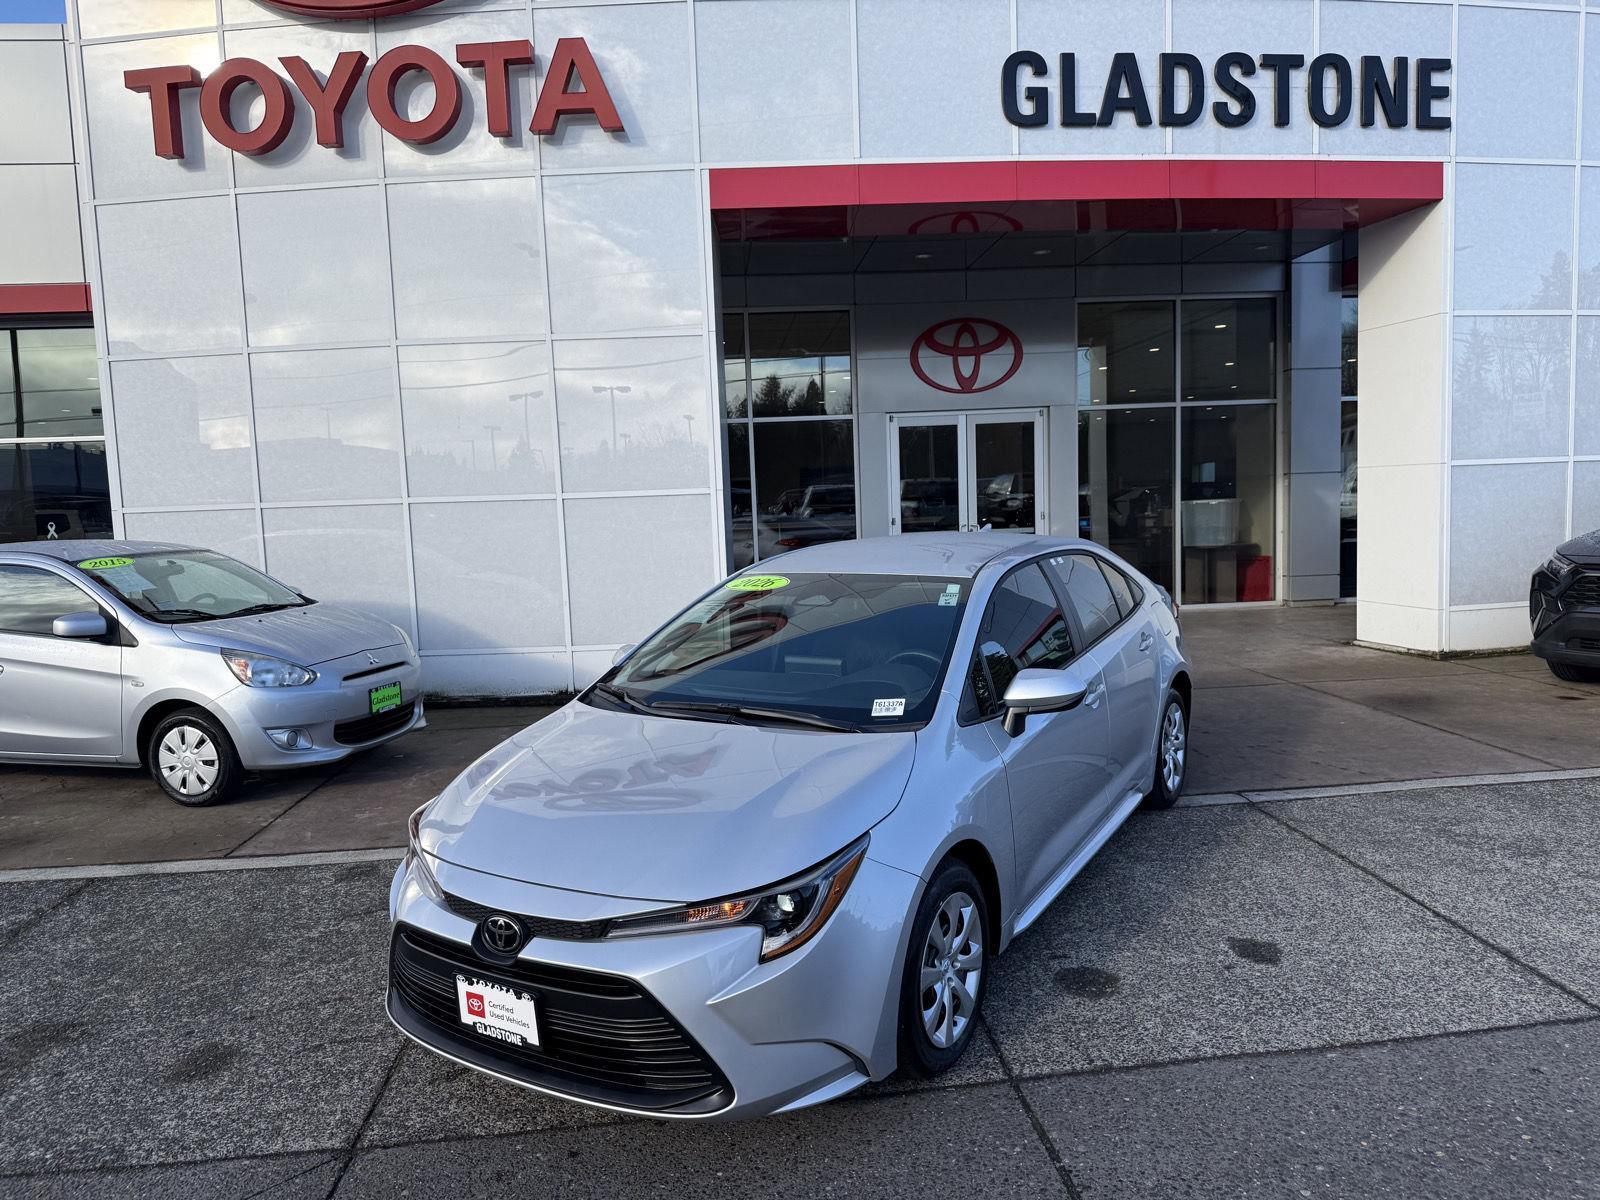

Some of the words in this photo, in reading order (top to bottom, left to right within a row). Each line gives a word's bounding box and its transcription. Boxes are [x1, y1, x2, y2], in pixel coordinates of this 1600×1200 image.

[124, 37, 624, 160] TOYOTA
[1000, 50, 1452, 130] GLADSTONE
[88, 558, 127, 568] 2015
[472, 978, 516, 996] TOYOTA
[488, 1000, 514, 1014] Certified
[489, 1011, 505, 1021] Used
[505, 1015, 530, 1029] Vehicles
[476, 1022, 523, 1047] GLADSTONE
